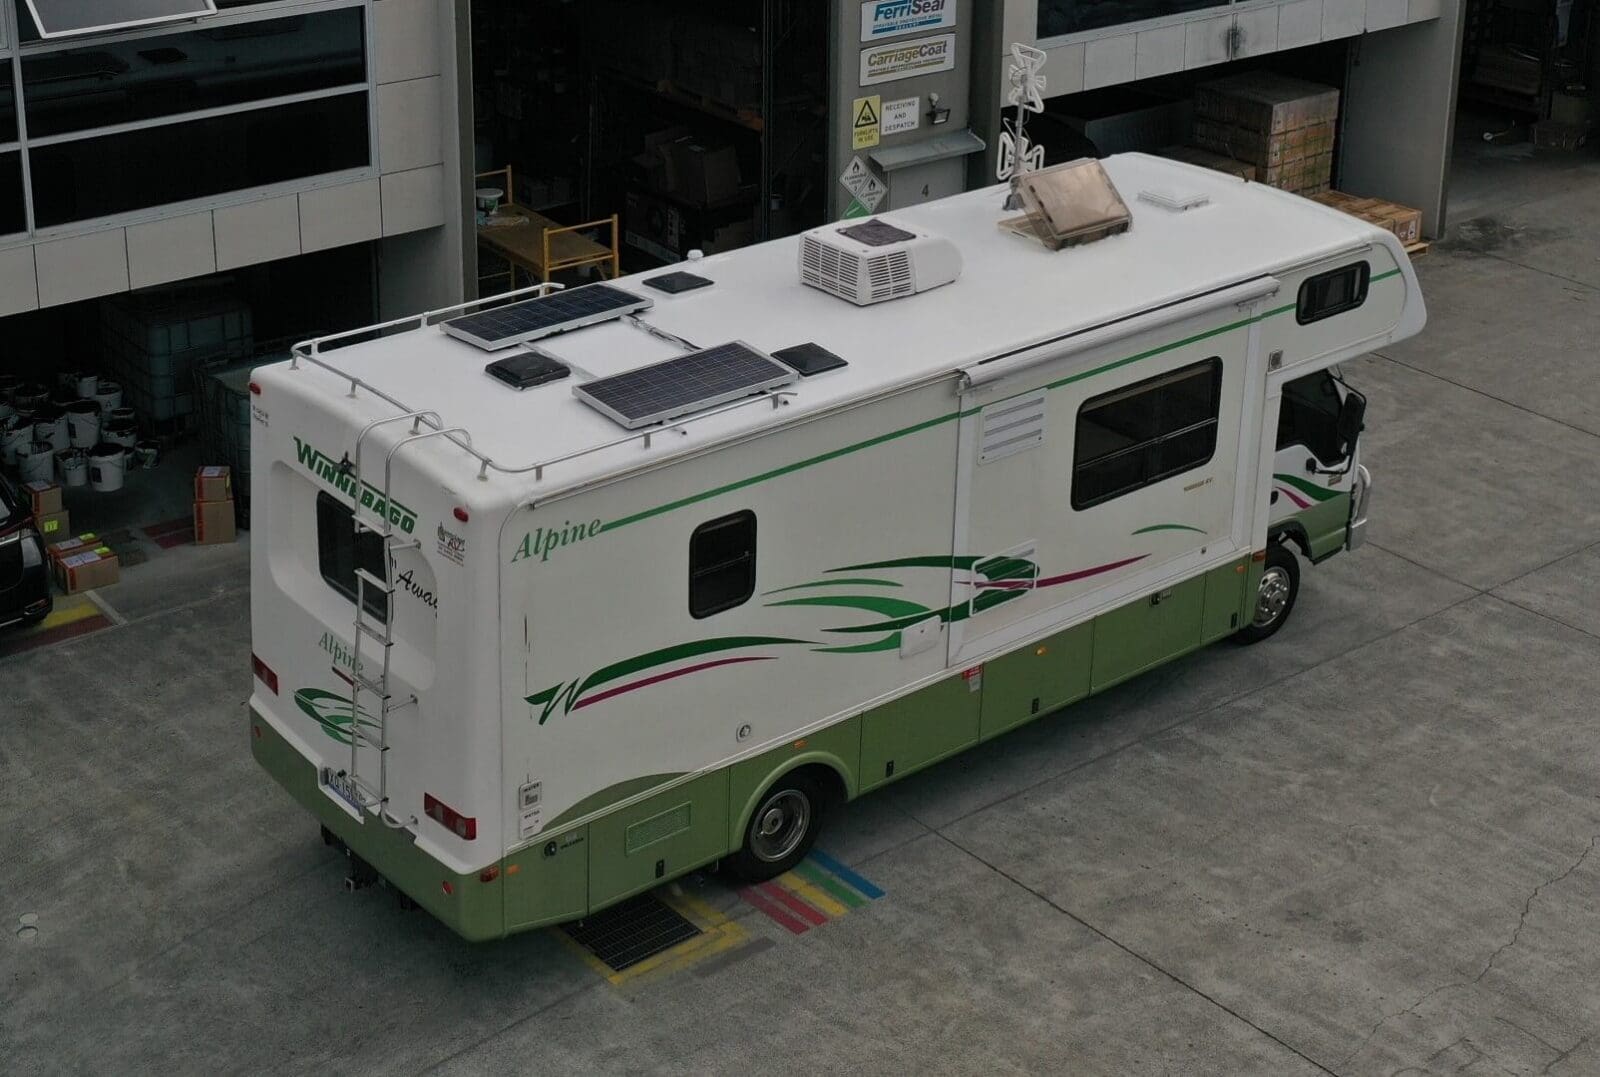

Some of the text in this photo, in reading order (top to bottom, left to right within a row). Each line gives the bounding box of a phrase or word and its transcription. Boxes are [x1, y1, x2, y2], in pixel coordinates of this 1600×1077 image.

[874, 0, 945, 21] FerriSeal
[867, 40, 947, 67] CarriageCoat
[885, 100, 916, 111] RECEIVING
[884, 121, 915, 131] DESPATCH
[921, 184, 929, 197] 4
[293, 436, 417, 534] WINNEBAGO
[511, 519, 601, 563] Alpine
[319, 632, 364, 674] Alpine
